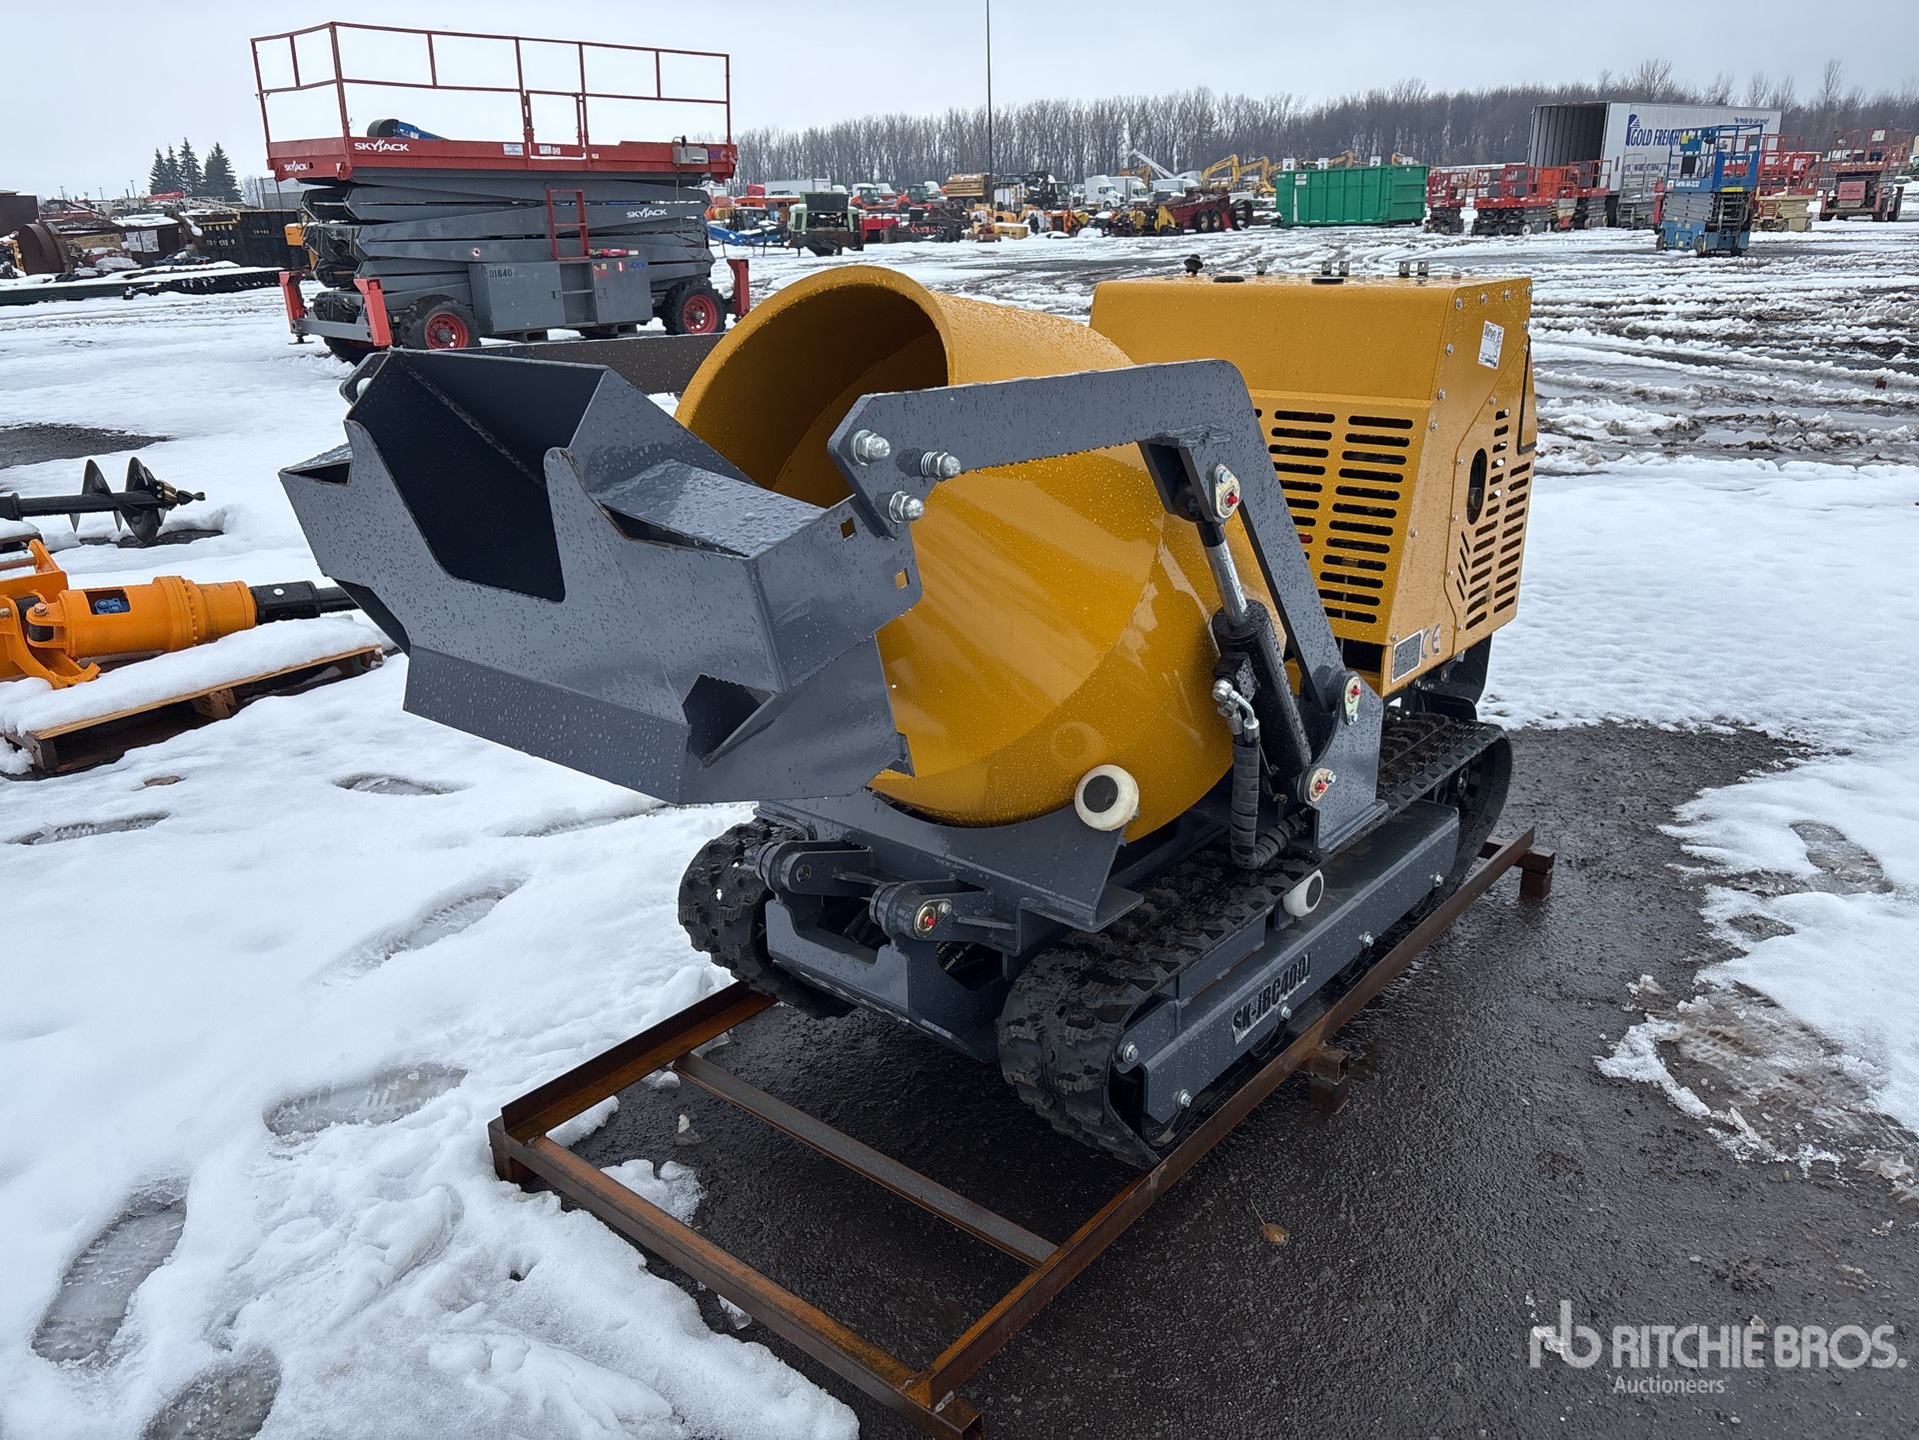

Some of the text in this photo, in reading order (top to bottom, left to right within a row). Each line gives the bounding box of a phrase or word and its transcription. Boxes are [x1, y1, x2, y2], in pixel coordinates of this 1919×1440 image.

[1630, 129, 1653, 147] GOLD
[354, 139, 410, 153] SKYJACK
[284, 160, 308, 172] SKYJACK
[1285, 162, 1291, 170] 4
[626, 207, 668, 218] SKYJACK
[489, 268, 513, 279] 01840
